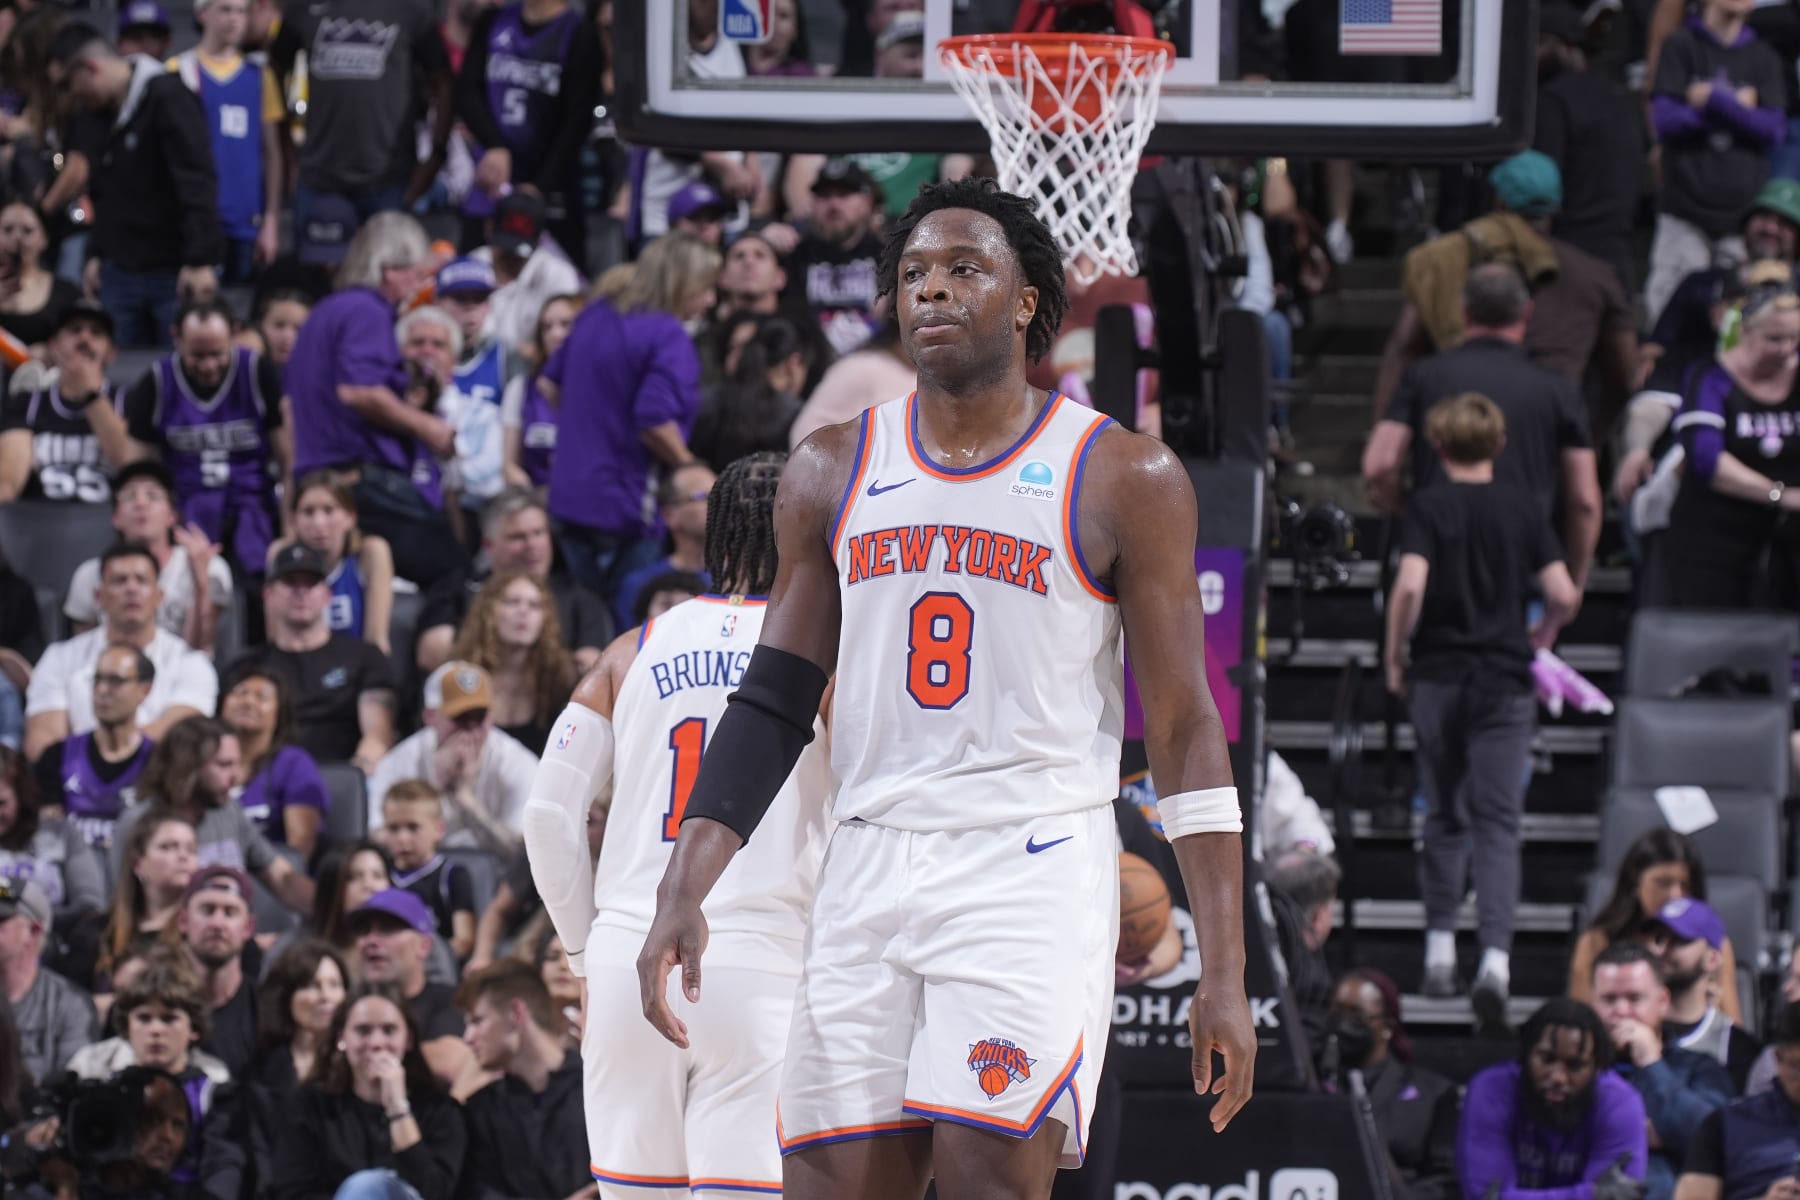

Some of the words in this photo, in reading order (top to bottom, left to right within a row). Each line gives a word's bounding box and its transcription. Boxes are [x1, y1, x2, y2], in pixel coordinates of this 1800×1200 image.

[727, 13, 753, 34] NBA
[502, 87, 529, 125] 5
[1011, 485, 1054, 499] sphere
[848, 524, 938, 587] NEW
[941, 524, 1053, 598] YORK
[906, 591, 975, 710] 8
[650, 650, 751, 700] BRUNS
[967, 1039, 1031, 1079] KNICKS
